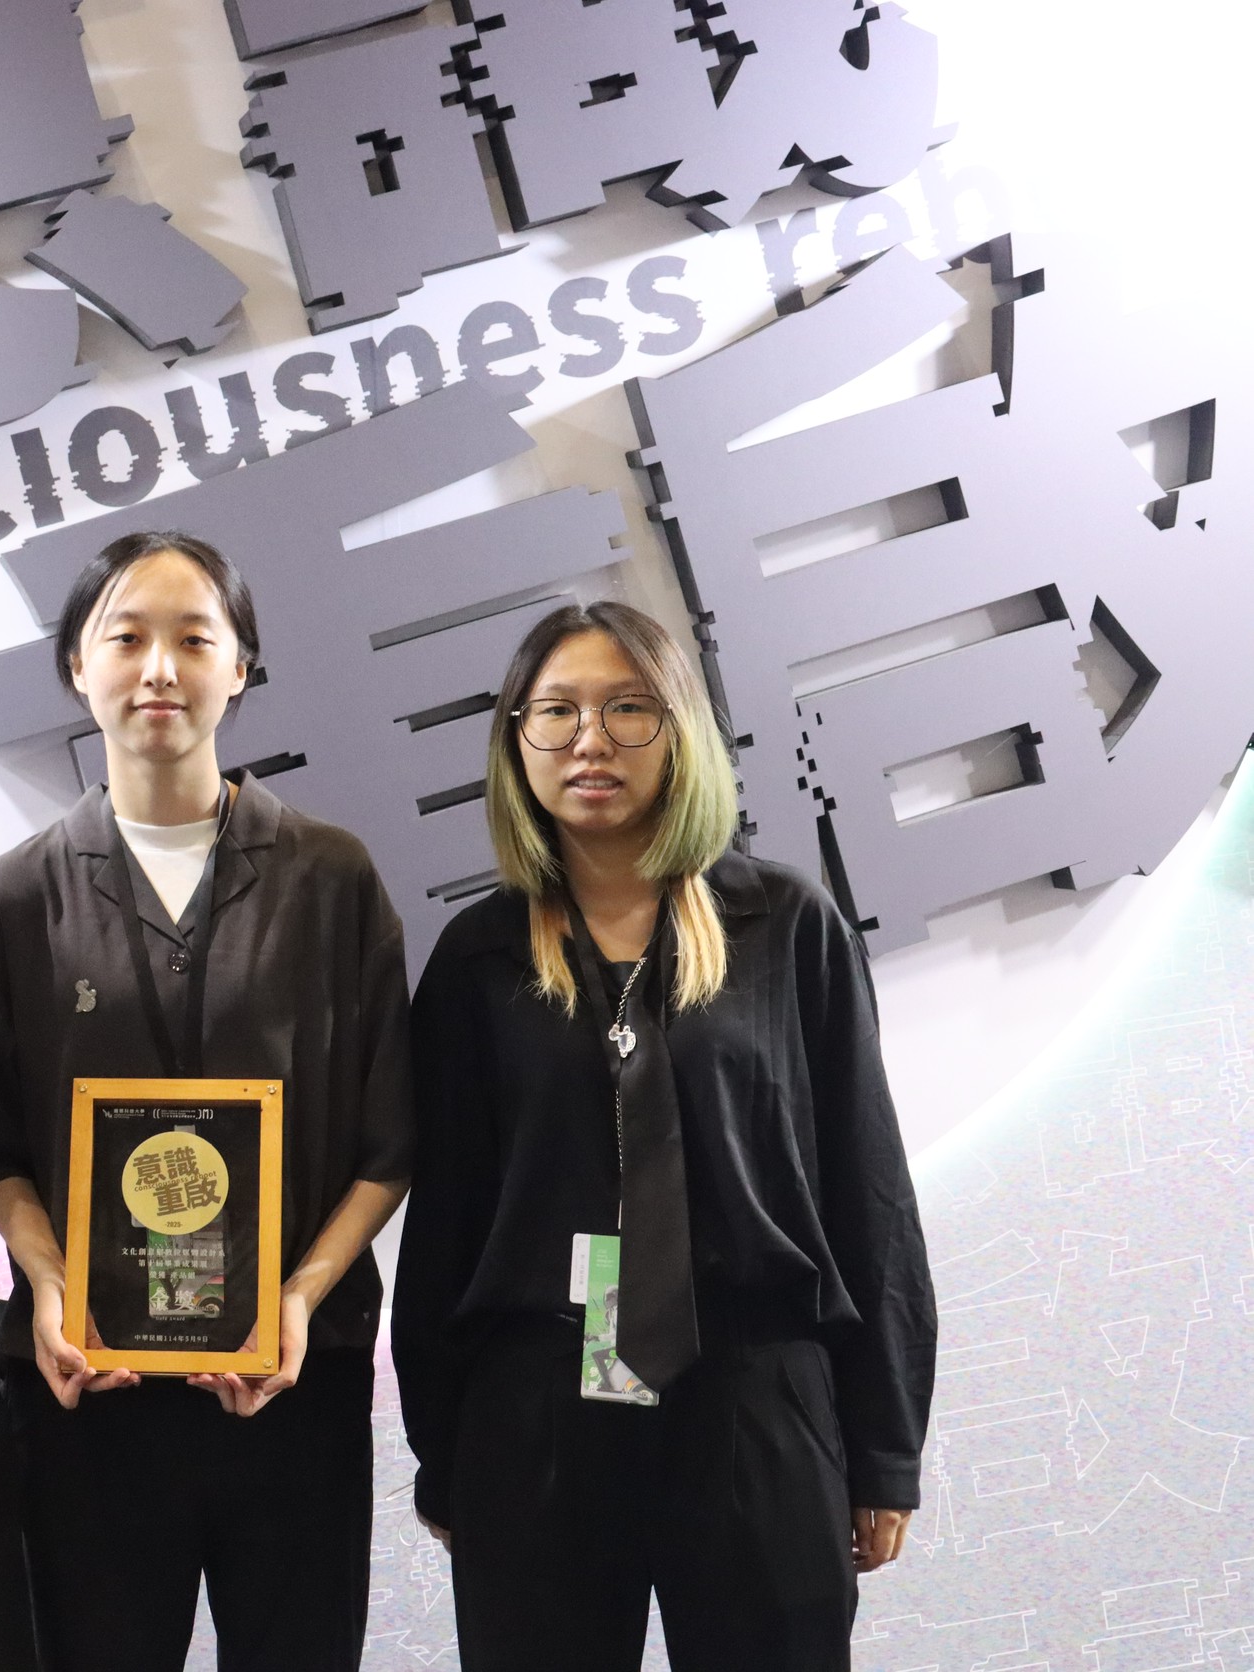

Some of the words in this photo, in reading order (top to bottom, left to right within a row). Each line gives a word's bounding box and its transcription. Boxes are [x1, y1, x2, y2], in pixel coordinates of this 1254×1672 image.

[133, 1146, 200, 1186] 意識
[134, 1176, 189, 1192] consciousness
[153, 1178, 221, 1217] 重啟
